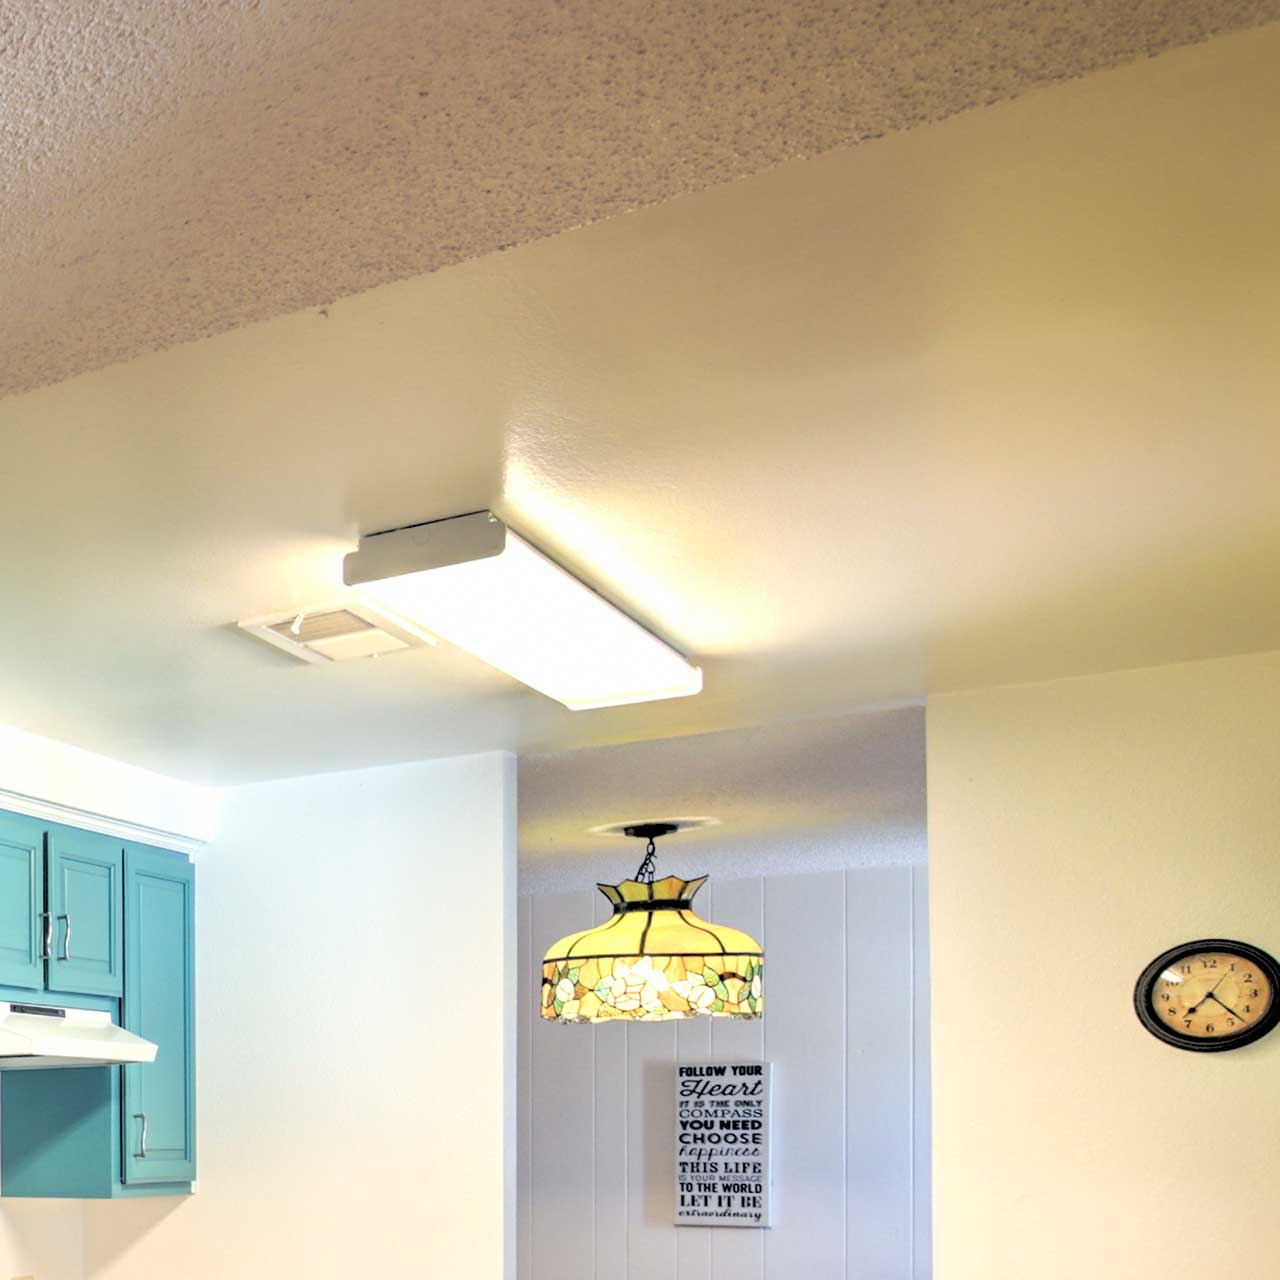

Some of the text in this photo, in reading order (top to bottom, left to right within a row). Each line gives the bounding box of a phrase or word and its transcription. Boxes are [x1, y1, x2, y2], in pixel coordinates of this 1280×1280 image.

[1201, 959, 1217, 968] 12
[1243, 973, 1252, 983] 2
[1161, 993, 1170, 1001] 9
[1250, 989, 1258, 998] 3
[1168, 1008, 1176, 1016] 8
[1243, 1005, 1250, 1013] 4
[1184, 1020, 1192, 1028] 7
[1226, 1018, 1235, 1027] 5
[1206, 1024, 1214, 1033] 6
[679, 1065, 762, 1077] FOLLOW YOUR
[680, 1079, 763, 1099] Heart
[693, 1100, 704, 1108] IS
[709, 1100, 730, 1108] THE
[734, 1100, 763, 1108] ONLY
[679, 1109, 763, 1118] COMPASS
[680, 1120, 762, 1130] YOU NEED
[679, 1133, 762, 1144] CHOOSE
[679, 1146, 760, 1161] happiness
[679, 1162, 762, 1173] THIS LIFE
[680, 1182, 762, 1193] TO THE WORLD
[680, 1195, 762, 1208] LET IT BE
[678, 1208, 762, 1222] extraordinary
